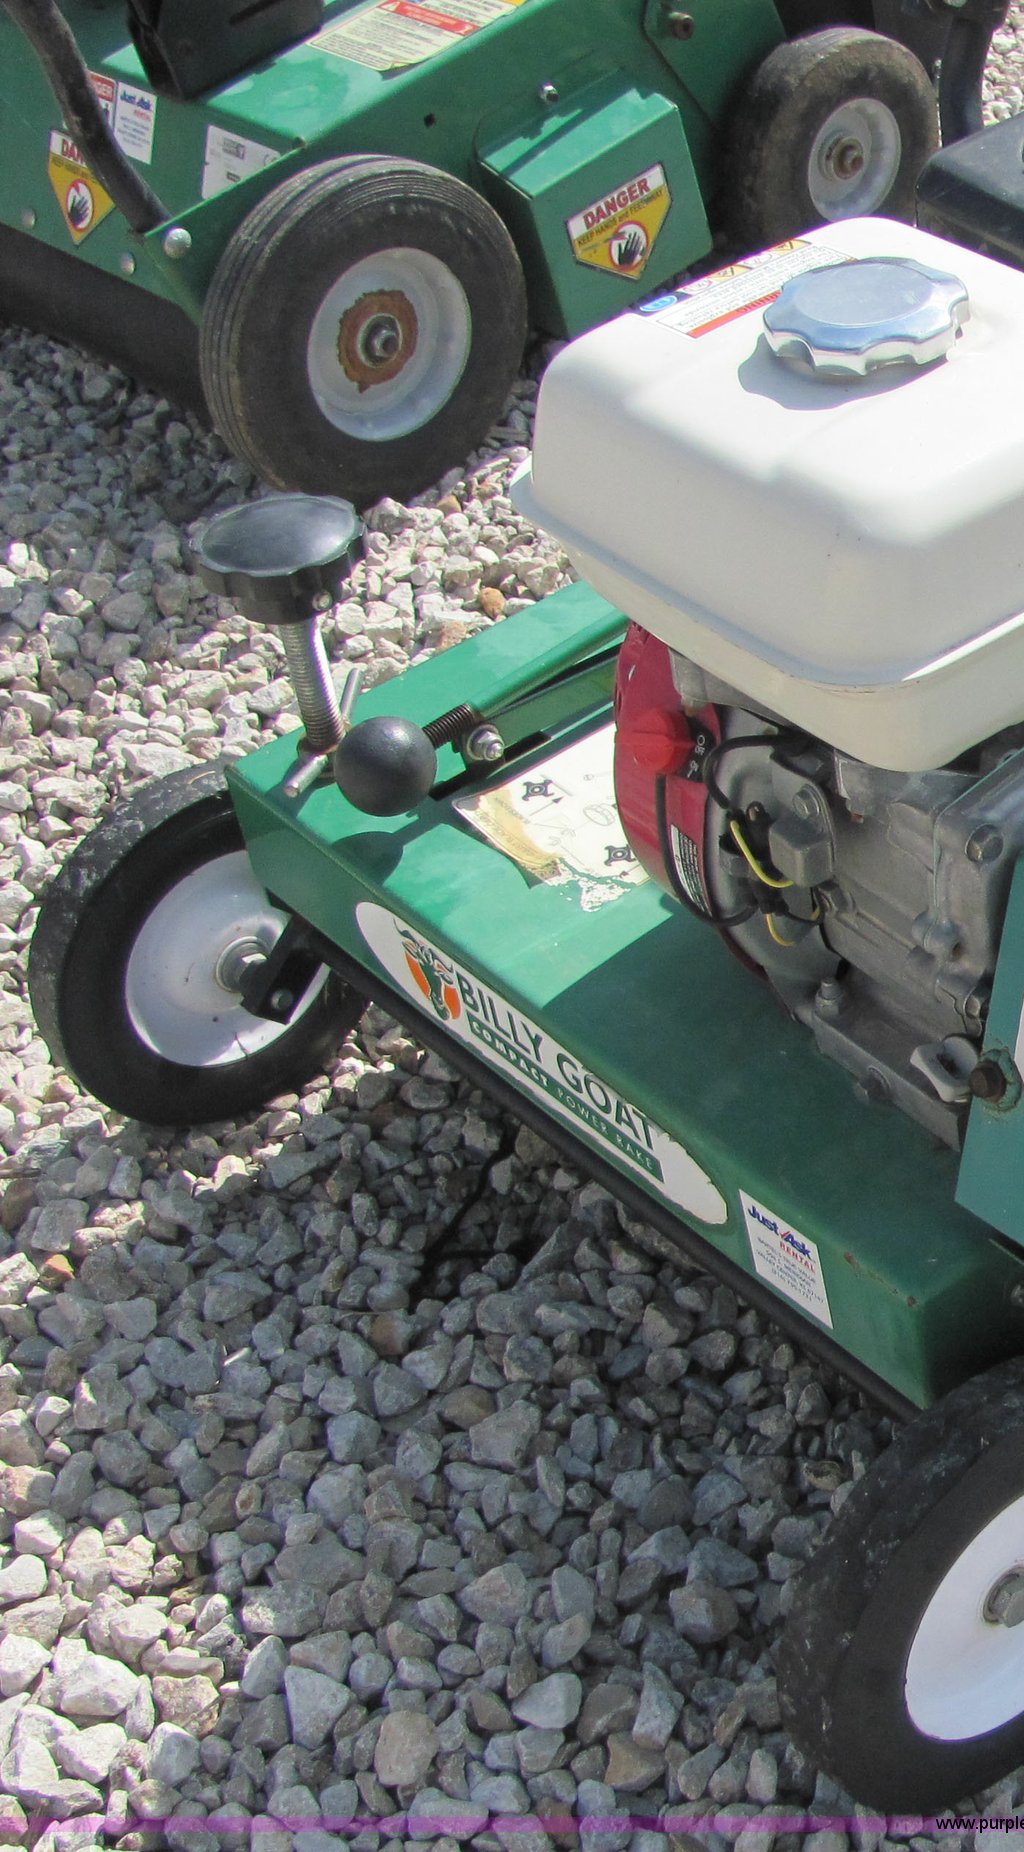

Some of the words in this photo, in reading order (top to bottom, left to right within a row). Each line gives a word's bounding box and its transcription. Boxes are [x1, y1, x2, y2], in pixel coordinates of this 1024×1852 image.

[583, 178, 650, 230] DANGER
[456, 970, 543, 1064] BILLY
[557, 1053, 654, 1150] GOAT
[472, 1020, 549, 1087] COMPACT
[558, 1088, 608, 1136] POWER
[616, 1134, 654, 1171] RAKE
[748, 1205, 779, 1236] Just
[784, 1233, 813, 1261] Ask
[780, 1241, 816, 1275] RENTAL
